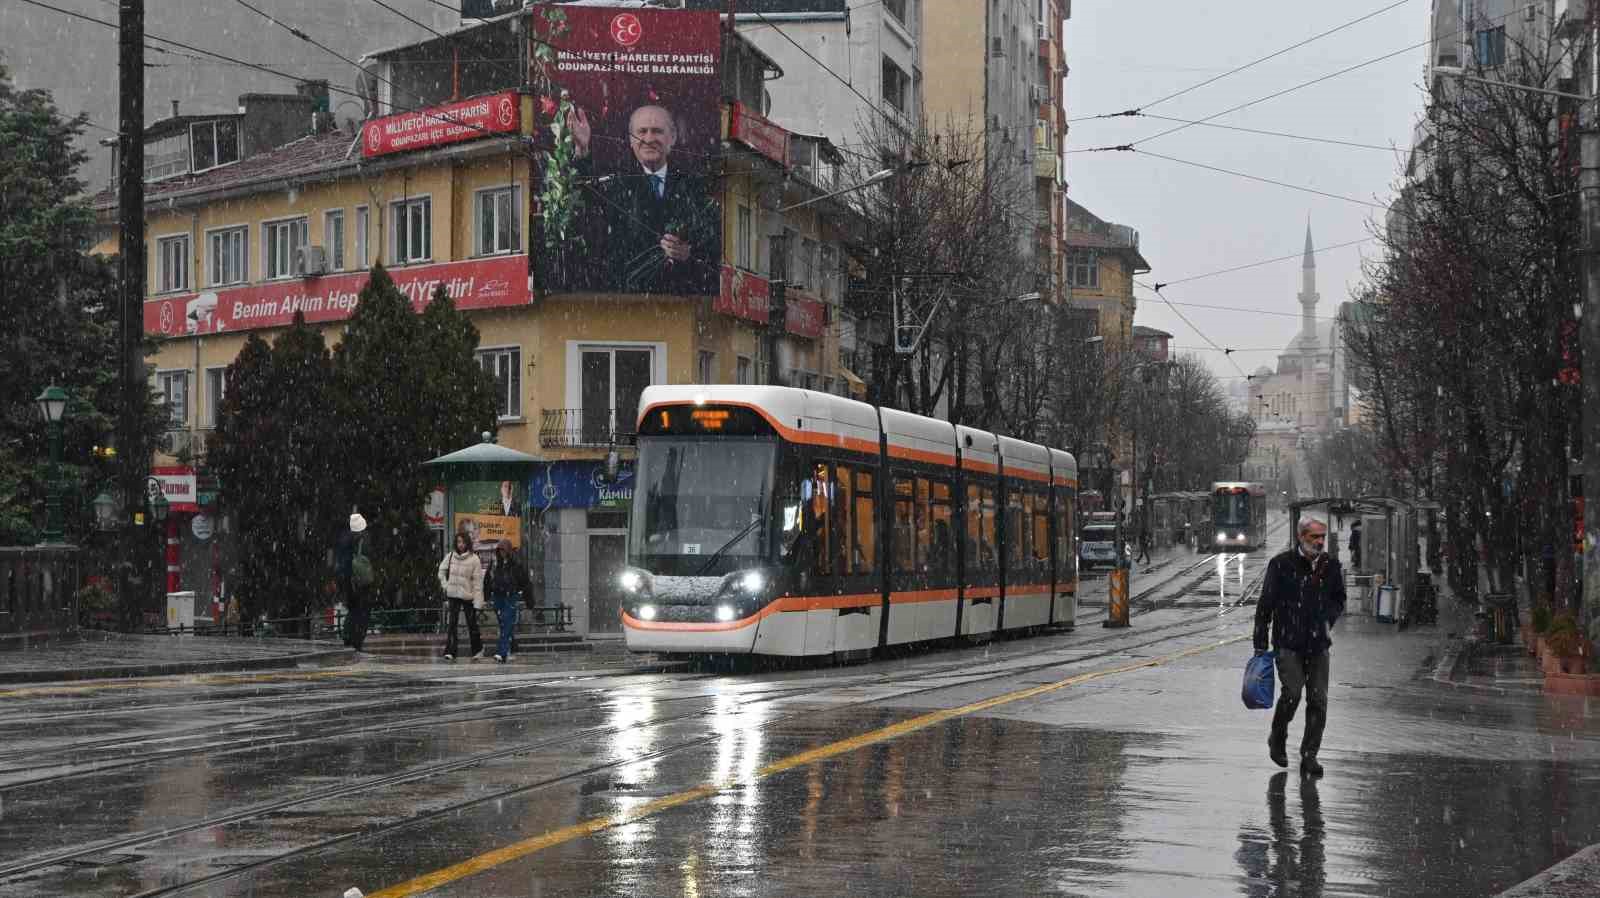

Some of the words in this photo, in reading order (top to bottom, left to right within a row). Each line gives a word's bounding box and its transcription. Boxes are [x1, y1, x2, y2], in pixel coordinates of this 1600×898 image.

[622, 52, 671, 62] HAREKET
[672, 53, 713, 64] PARTİSİ
[627, 62, 649, 73] İLÇE
[652, 64, 713, 74] BAŞKANLIĞI
[386, 112, 423, 134] MİLLİYETÇİ
[461, 102, 488, 118] PARTİSİ
[232, 298, 277, 320] Benim
[280, 293, 323, 314] Aklım
[327, 290, 359, 313] Hep
